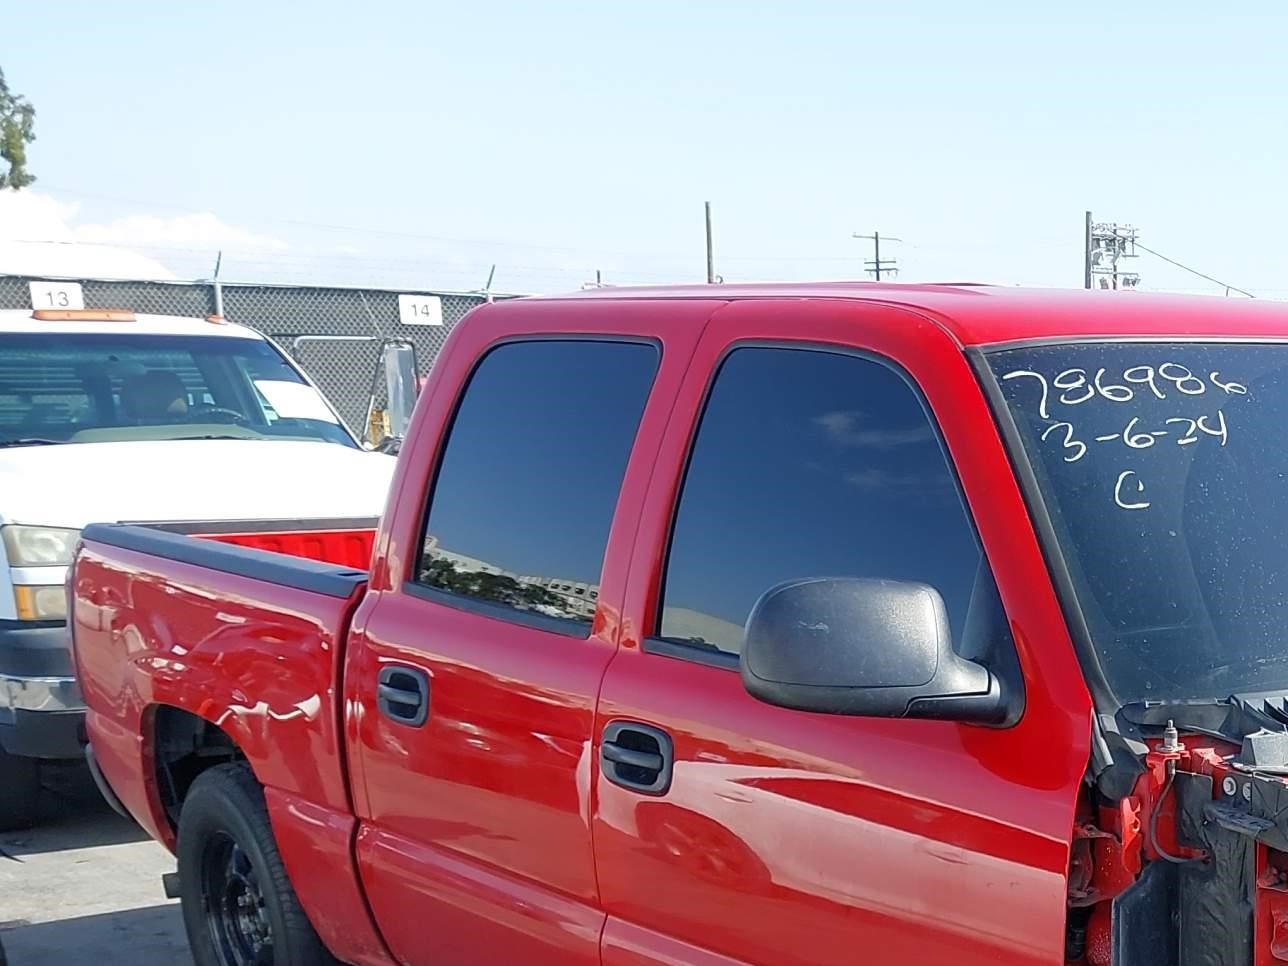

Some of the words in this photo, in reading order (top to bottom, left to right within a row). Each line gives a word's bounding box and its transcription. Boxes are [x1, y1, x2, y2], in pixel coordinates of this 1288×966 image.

[46, 291, 69, 307] 13
[411, 304, 430, 317] 14
[1002, 362, 1248, 419] 786986
[1040, 410, 1228, 463] 3-6-24
